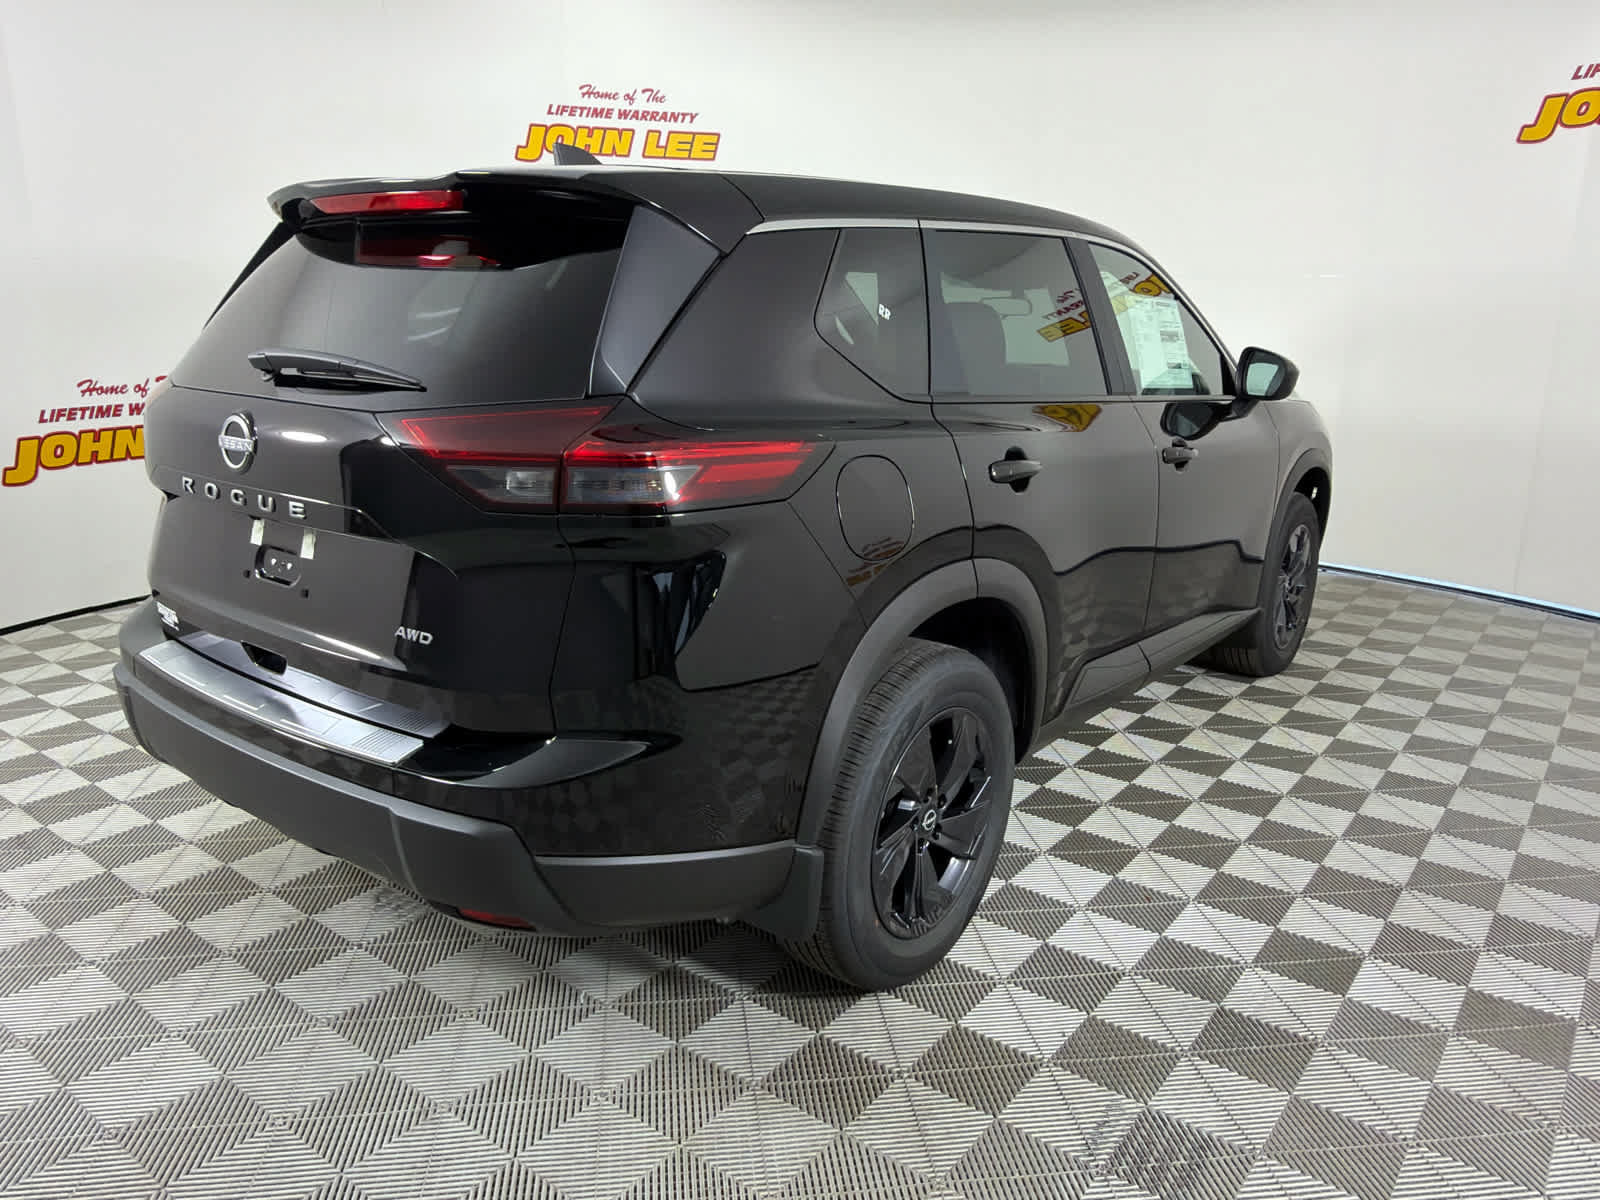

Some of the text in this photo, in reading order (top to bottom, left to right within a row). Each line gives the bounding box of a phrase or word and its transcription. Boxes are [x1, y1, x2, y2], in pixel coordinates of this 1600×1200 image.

[578, 83, 667, 106] Home of The
[547, 103, 699, 124] LIFETIME WARRANTY
[515, 123, 721, 162] JOHN LEE
[76, 377, 150, 398] Home of
[38, 403, 125, 424] LIFETIME
[2, 425, 145, 487] JOHN
[182, 475, 308, 520] ROGUE
[394, 626, 434, 645] AWD
